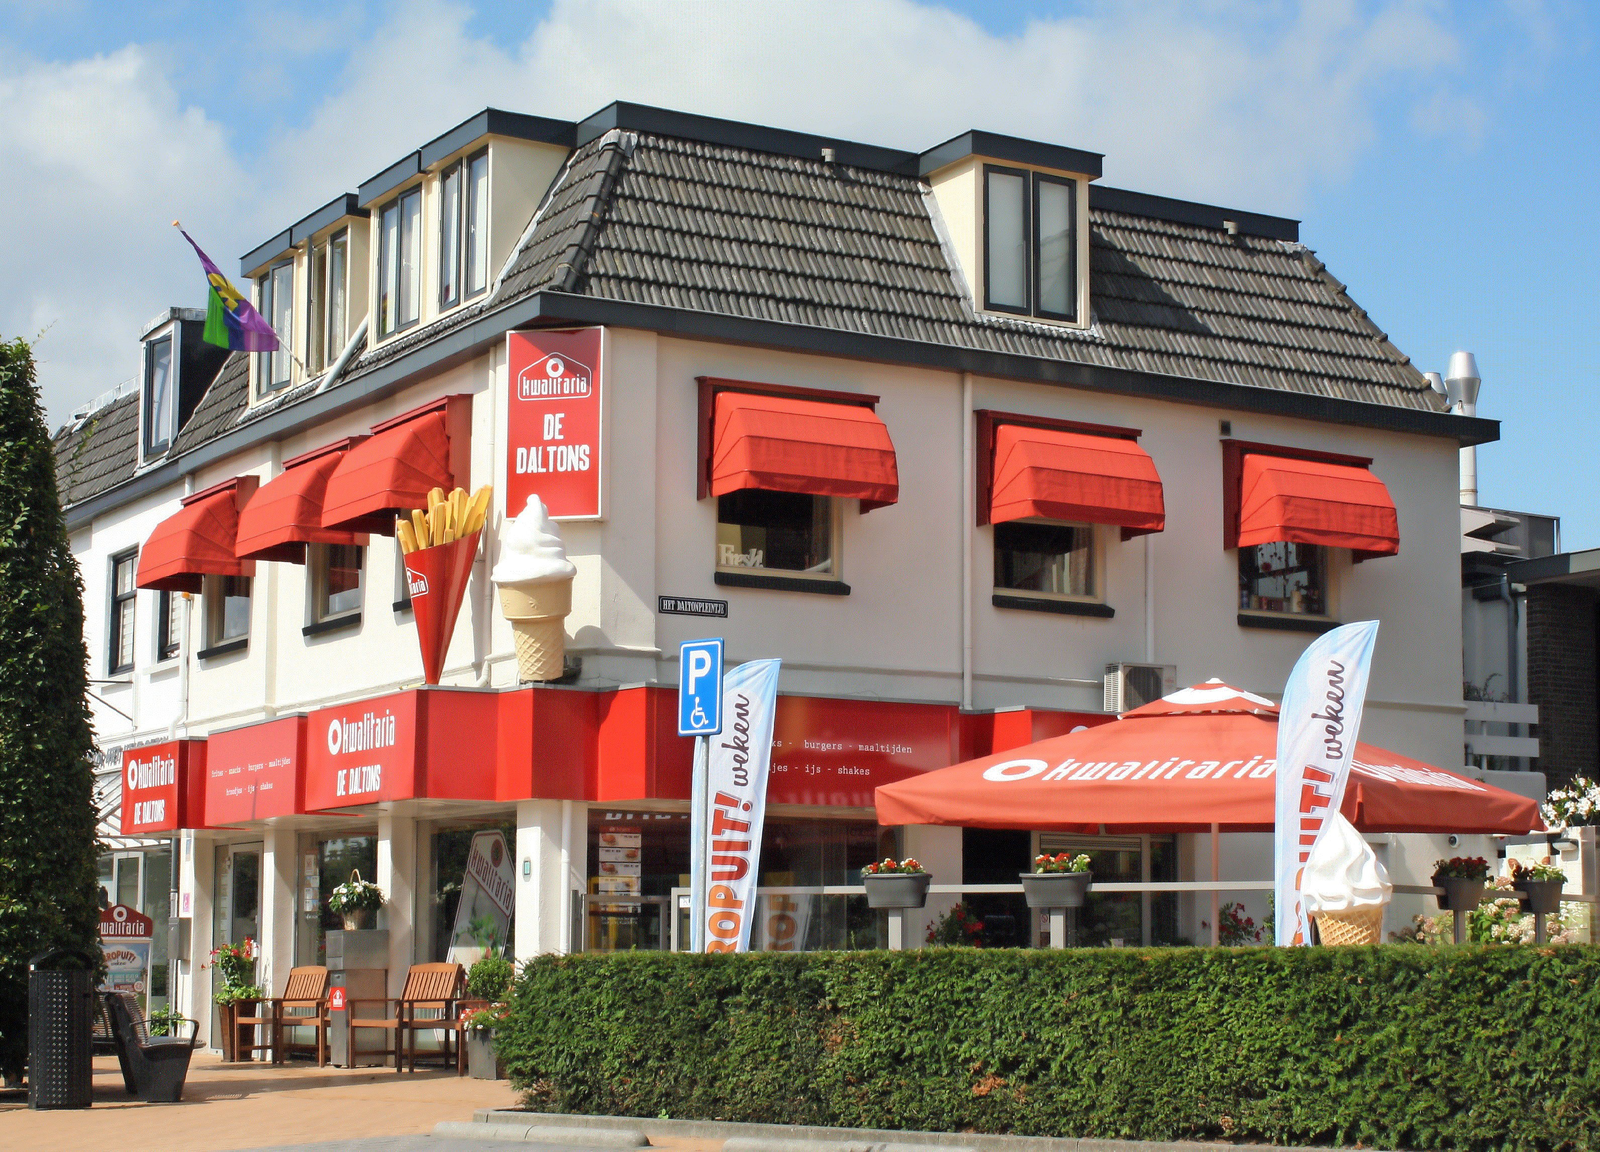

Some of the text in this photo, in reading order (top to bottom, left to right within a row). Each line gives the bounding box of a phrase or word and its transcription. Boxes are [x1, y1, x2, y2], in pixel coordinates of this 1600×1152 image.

[522, 374, 587, 396] kwalitaria
[543, 413, 565, 440] DE
[516, 444, 590, 474] DALTONS
[662, 600, 725, 614] HET DALTONPLEINTJE
[688, 650, 712, 695] P
[1311, 660, 1345, 760] weken
[342, 709, 395, 754] kwalitaria
[721, 693, 750, 787] weken
[804, 740, 843, 751] burgers
[858, 743, 912, 755] maaltijden
[138, 753, 175, 790] kwalitaria
[336, 764, 381, 797] DE DALTONS
[805, 764, 821, 775] ijs
[837, 766, 870, 775] shakes
[1042, 755, 1278, 780] kwalitaria
[134, 799, 165, 825] DE DALTONS
[470, 842, 513, 911] kwalitaria
[99, 920, 145, 935] walitaria
